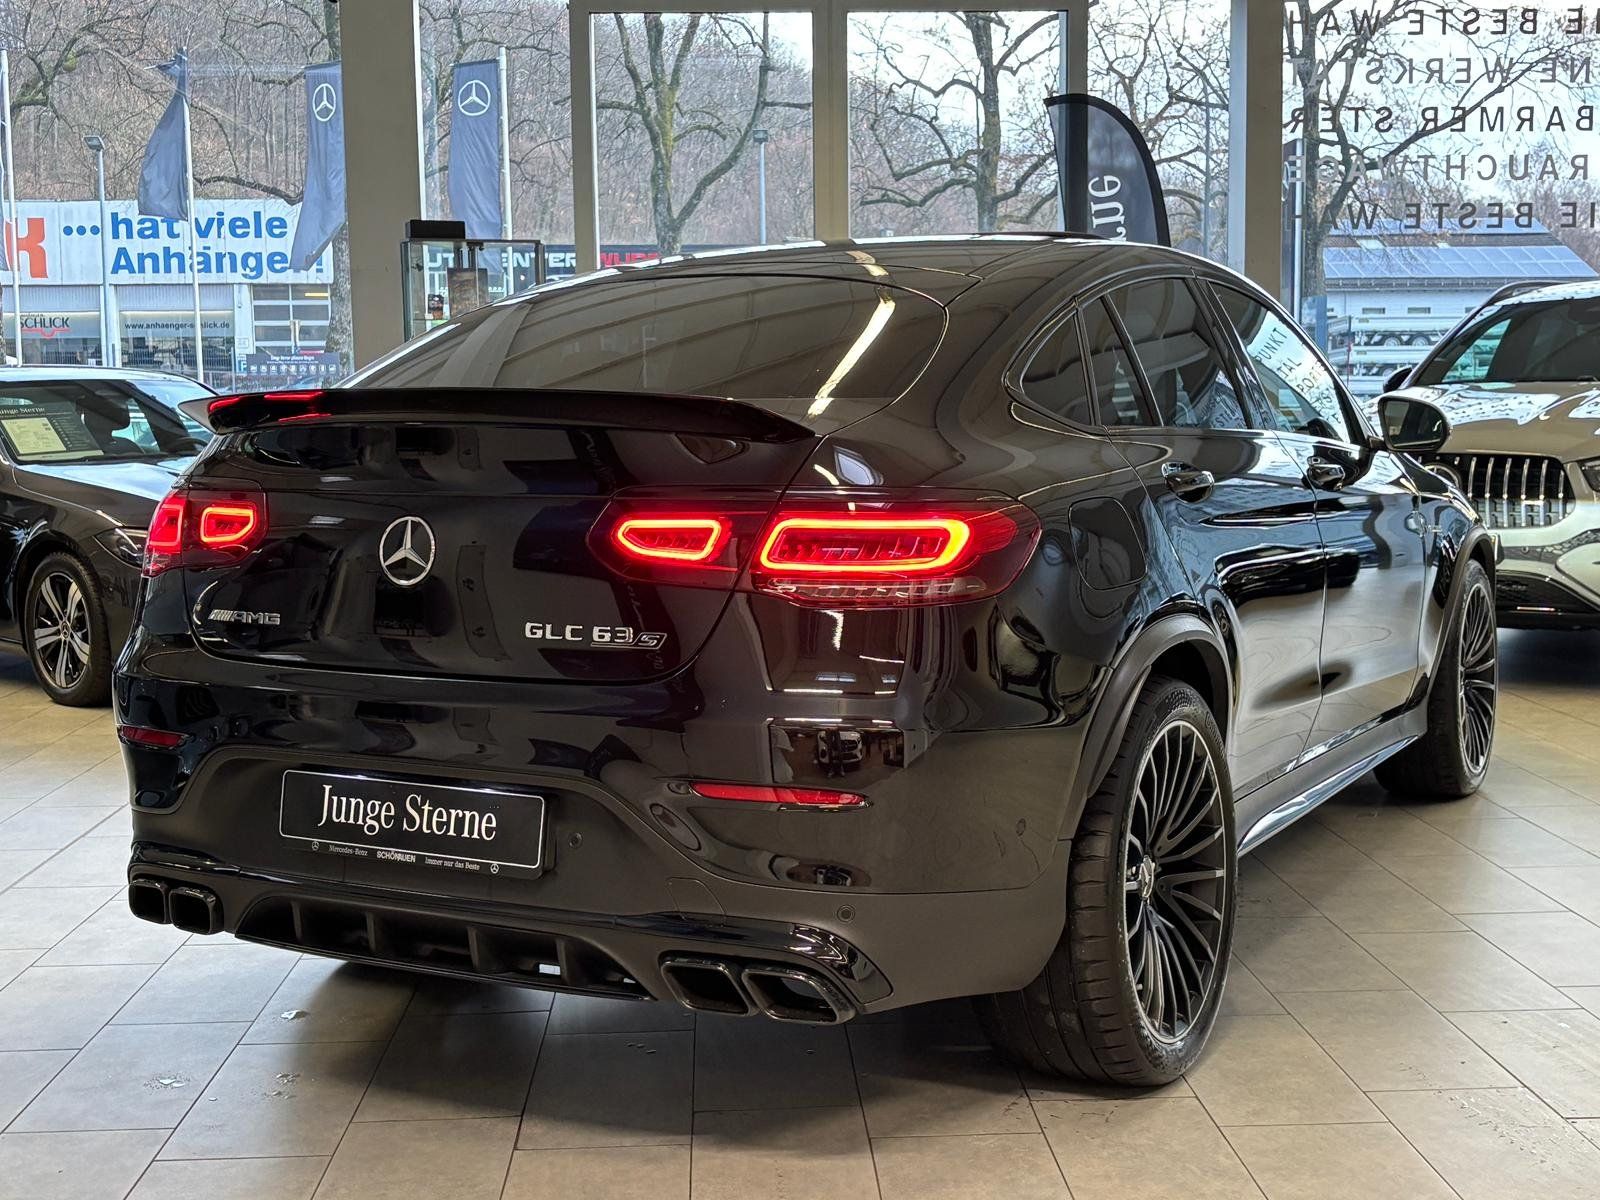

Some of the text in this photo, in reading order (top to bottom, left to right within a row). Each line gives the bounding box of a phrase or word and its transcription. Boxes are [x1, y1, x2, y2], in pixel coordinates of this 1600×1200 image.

[110, 211, 181, 240] hat
[194, 211, 288, 239] viele
[231, 610, 281, 626] AMG
[524, 622, 583, 641] GLC
[317, 784, 497, 841] Junge Sterne
[328, 844, 369, 857] Mercedes-Benz
[424, 856, 443, 867] Immer
[443, 860, 454, 868] nur
[454, 860, 465, 869] das
